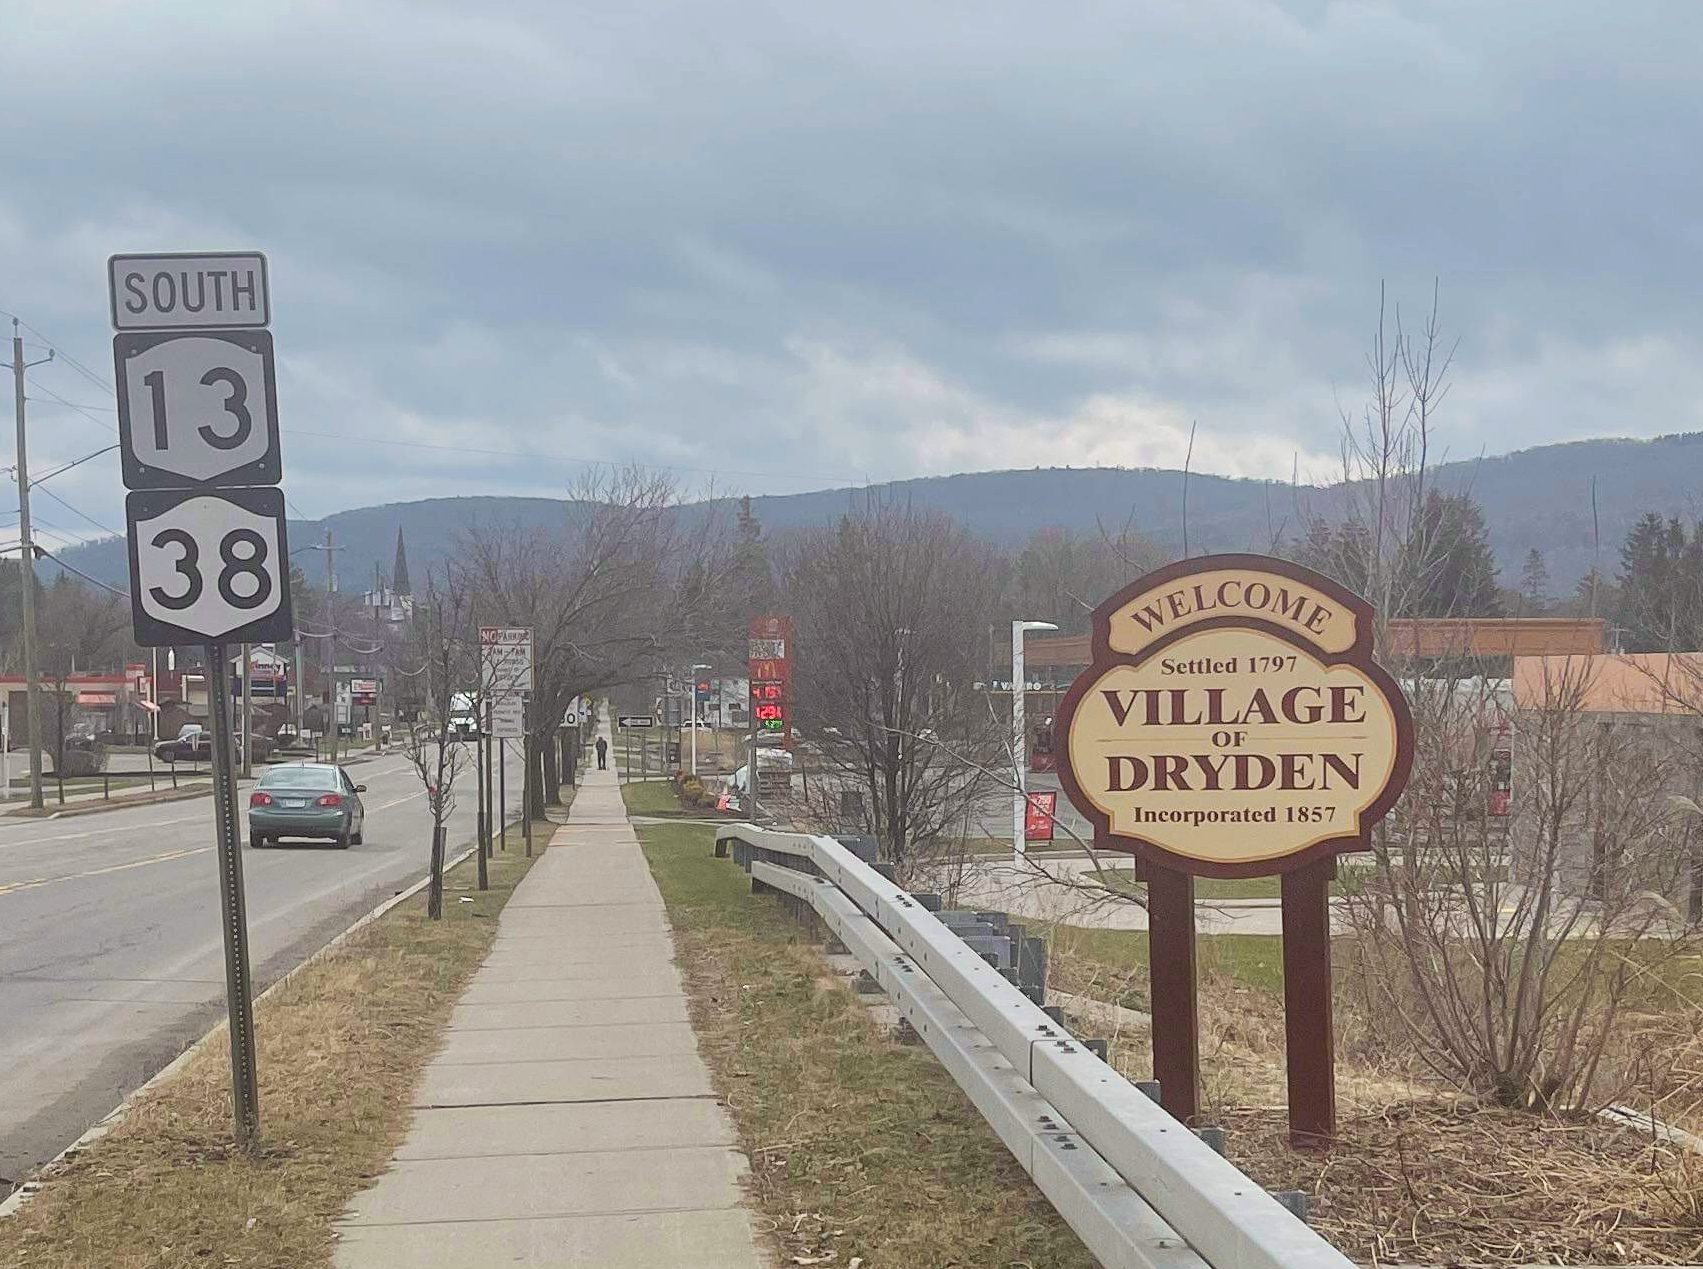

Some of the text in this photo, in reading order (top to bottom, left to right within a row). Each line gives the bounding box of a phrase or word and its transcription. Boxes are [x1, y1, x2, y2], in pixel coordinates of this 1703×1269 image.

[124, 270, 257, 314] SOUTH
[143, 366, 253, 452] 13
[148, 527, 272, 611] 38
[1130, 580, 1333, 636] WELCOME
[481, 630, 497, 643] NO
[1160, 656, 1298, 676] Settled 1797
[1100, 686, 1367, 728] VILLAGE
[1211, 731, 1248, 748] OF
[1104, 752, 1365, 793] DRYDEN
[1133, 805, 1336, 827] Incorporated 1857
